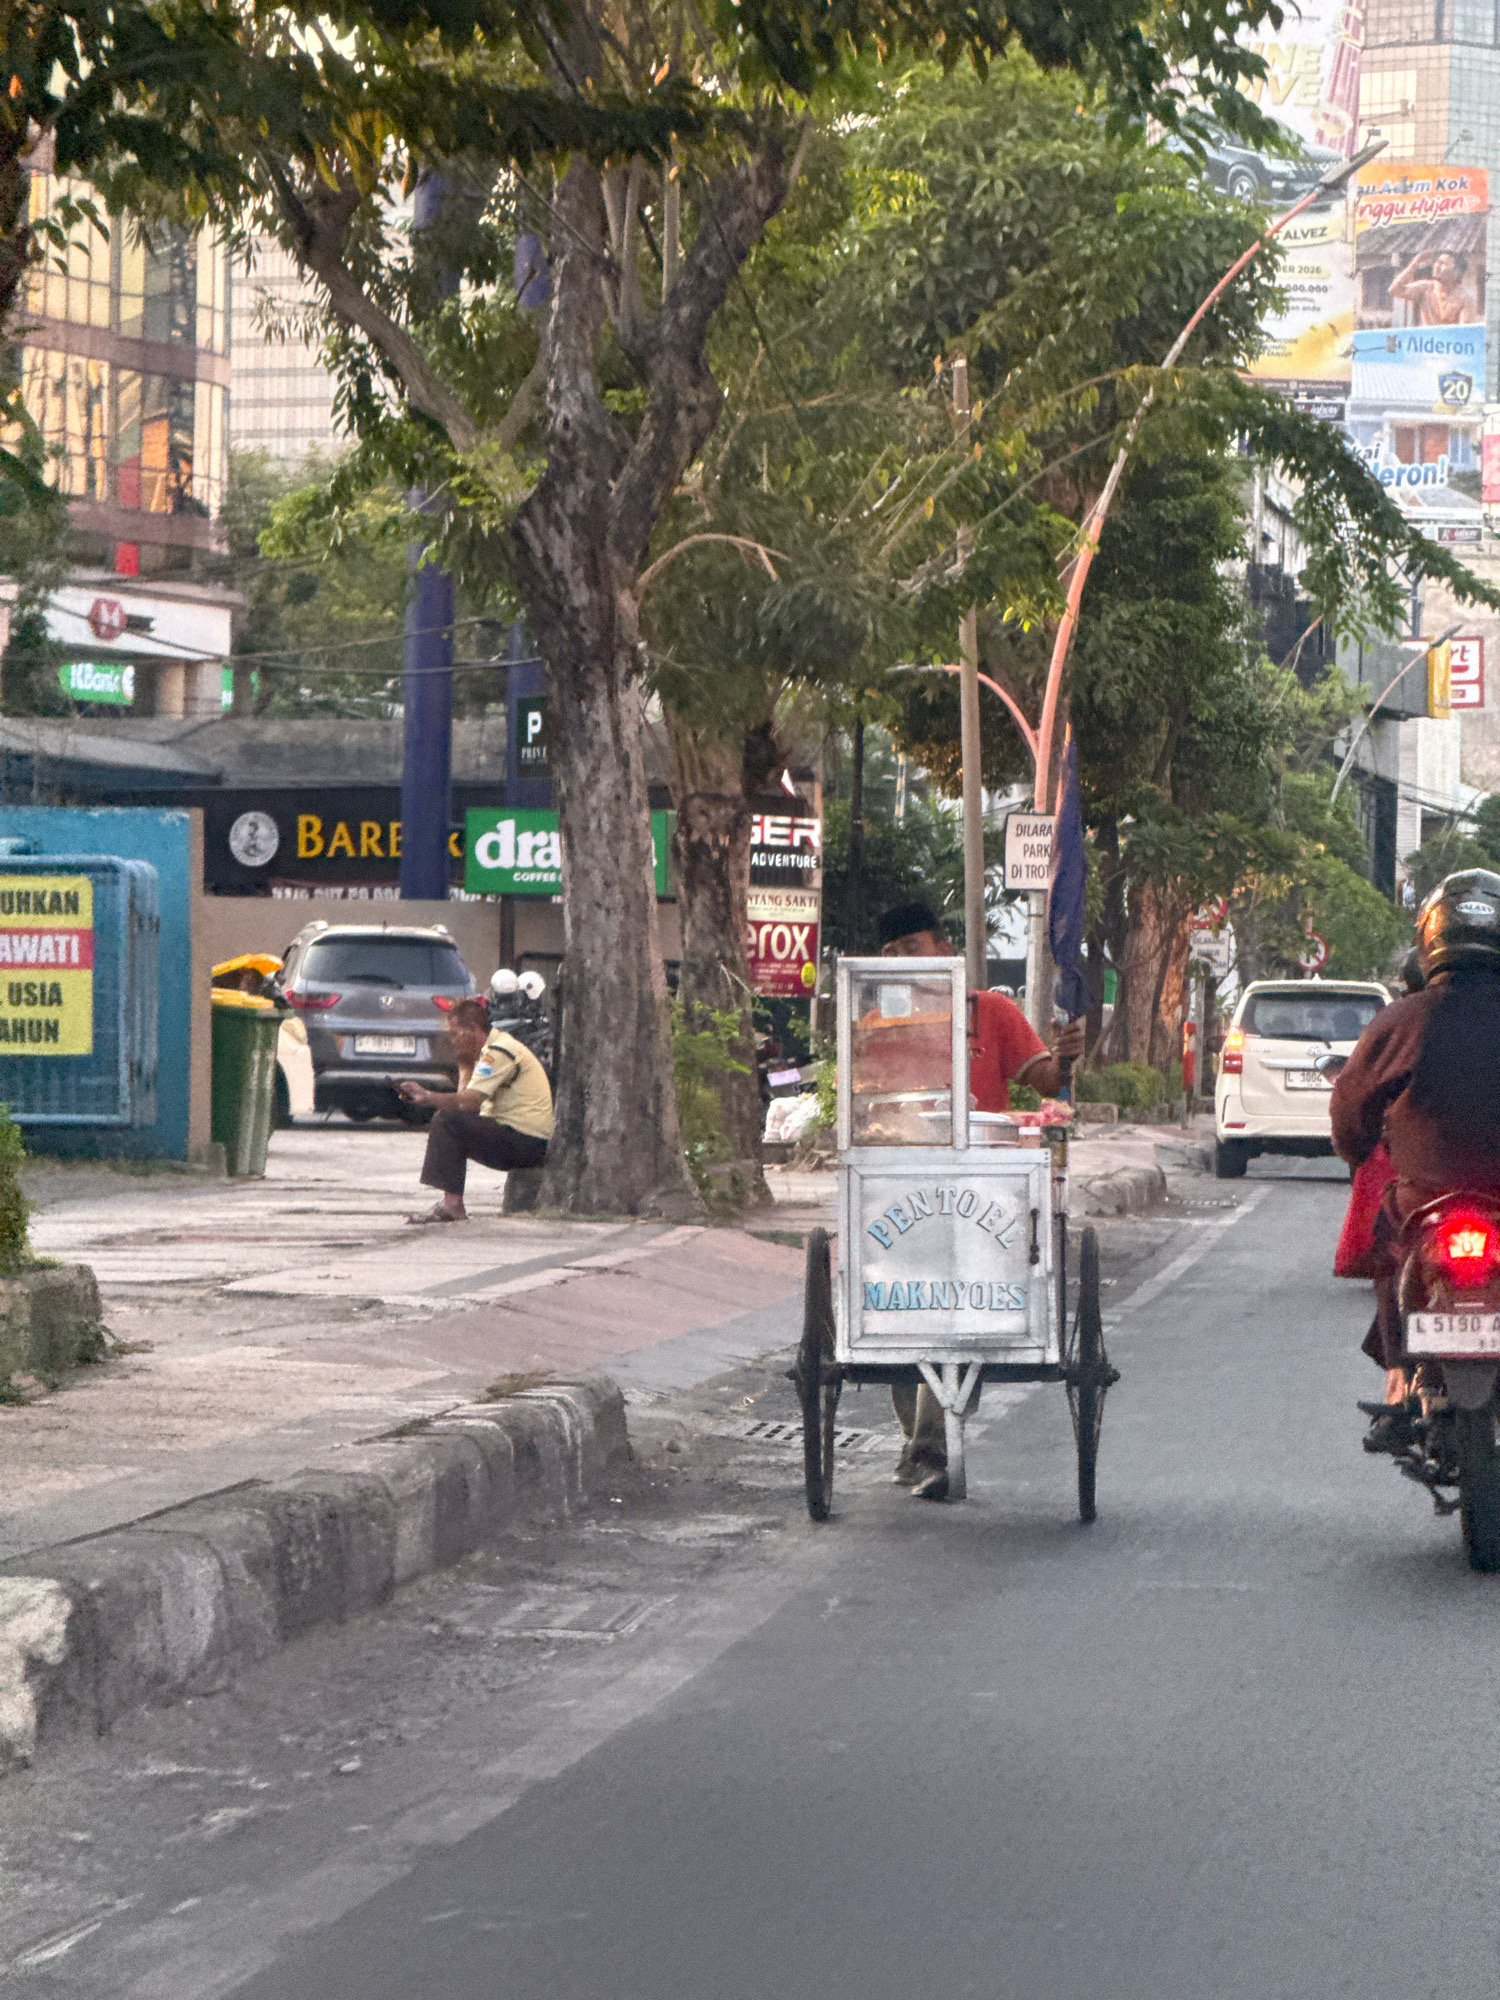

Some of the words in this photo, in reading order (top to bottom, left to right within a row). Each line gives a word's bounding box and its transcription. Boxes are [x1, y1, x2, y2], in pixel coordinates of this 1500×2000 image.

[1436, 176, 1470, 191] Kok
[1410, 196, 1464, 223] Hujan
[1283, 226, 1328, 240] ALVEZ
[1406, 336, 1475, 354] Alderon
[1443, 380, 1469, 400] 20
[1016, 823, 1053, 838] DILARA
[1023, 843, 1051, 858] PARK
[752, 852, 817, 869] ADVENTURE
[513, 872, 555, 882] COFFEE
[1011, 864, 1022, 879] DI
[1025, 864, 1049, 879] TROT
[748, 893, 782, 907] NTANG
[785, 894, 818, 908] SAKTI
[8, 982, 63, 1007] USIA
[867, 1186, 1022, 1250] PENTOEL
[863, 1281, 1029, 1311] MAKNYOES
[1416, 1316, 1427, 1334] L
